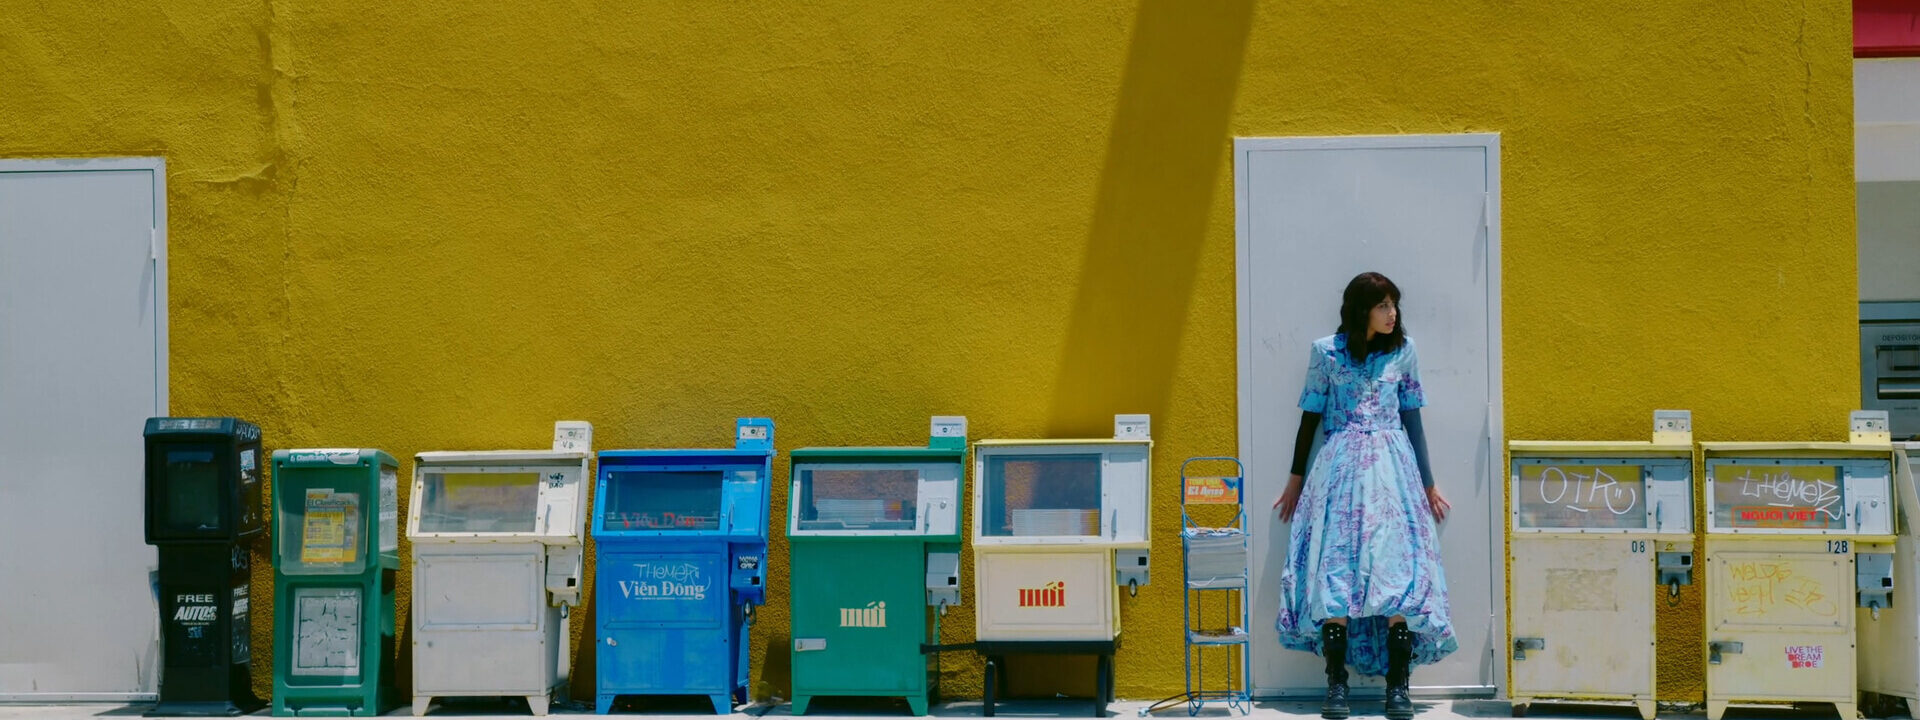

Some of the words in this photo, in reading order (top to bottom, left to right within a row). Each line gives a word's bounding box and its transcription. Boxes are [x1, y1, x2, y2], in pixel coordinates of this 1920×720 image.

[1826, 540, 1848, 553] 12B
[176, 594, 214, 603] FREE
[1784, 646, 1805, 654] LIVE
[1806, 645, 1823, 654] THE
